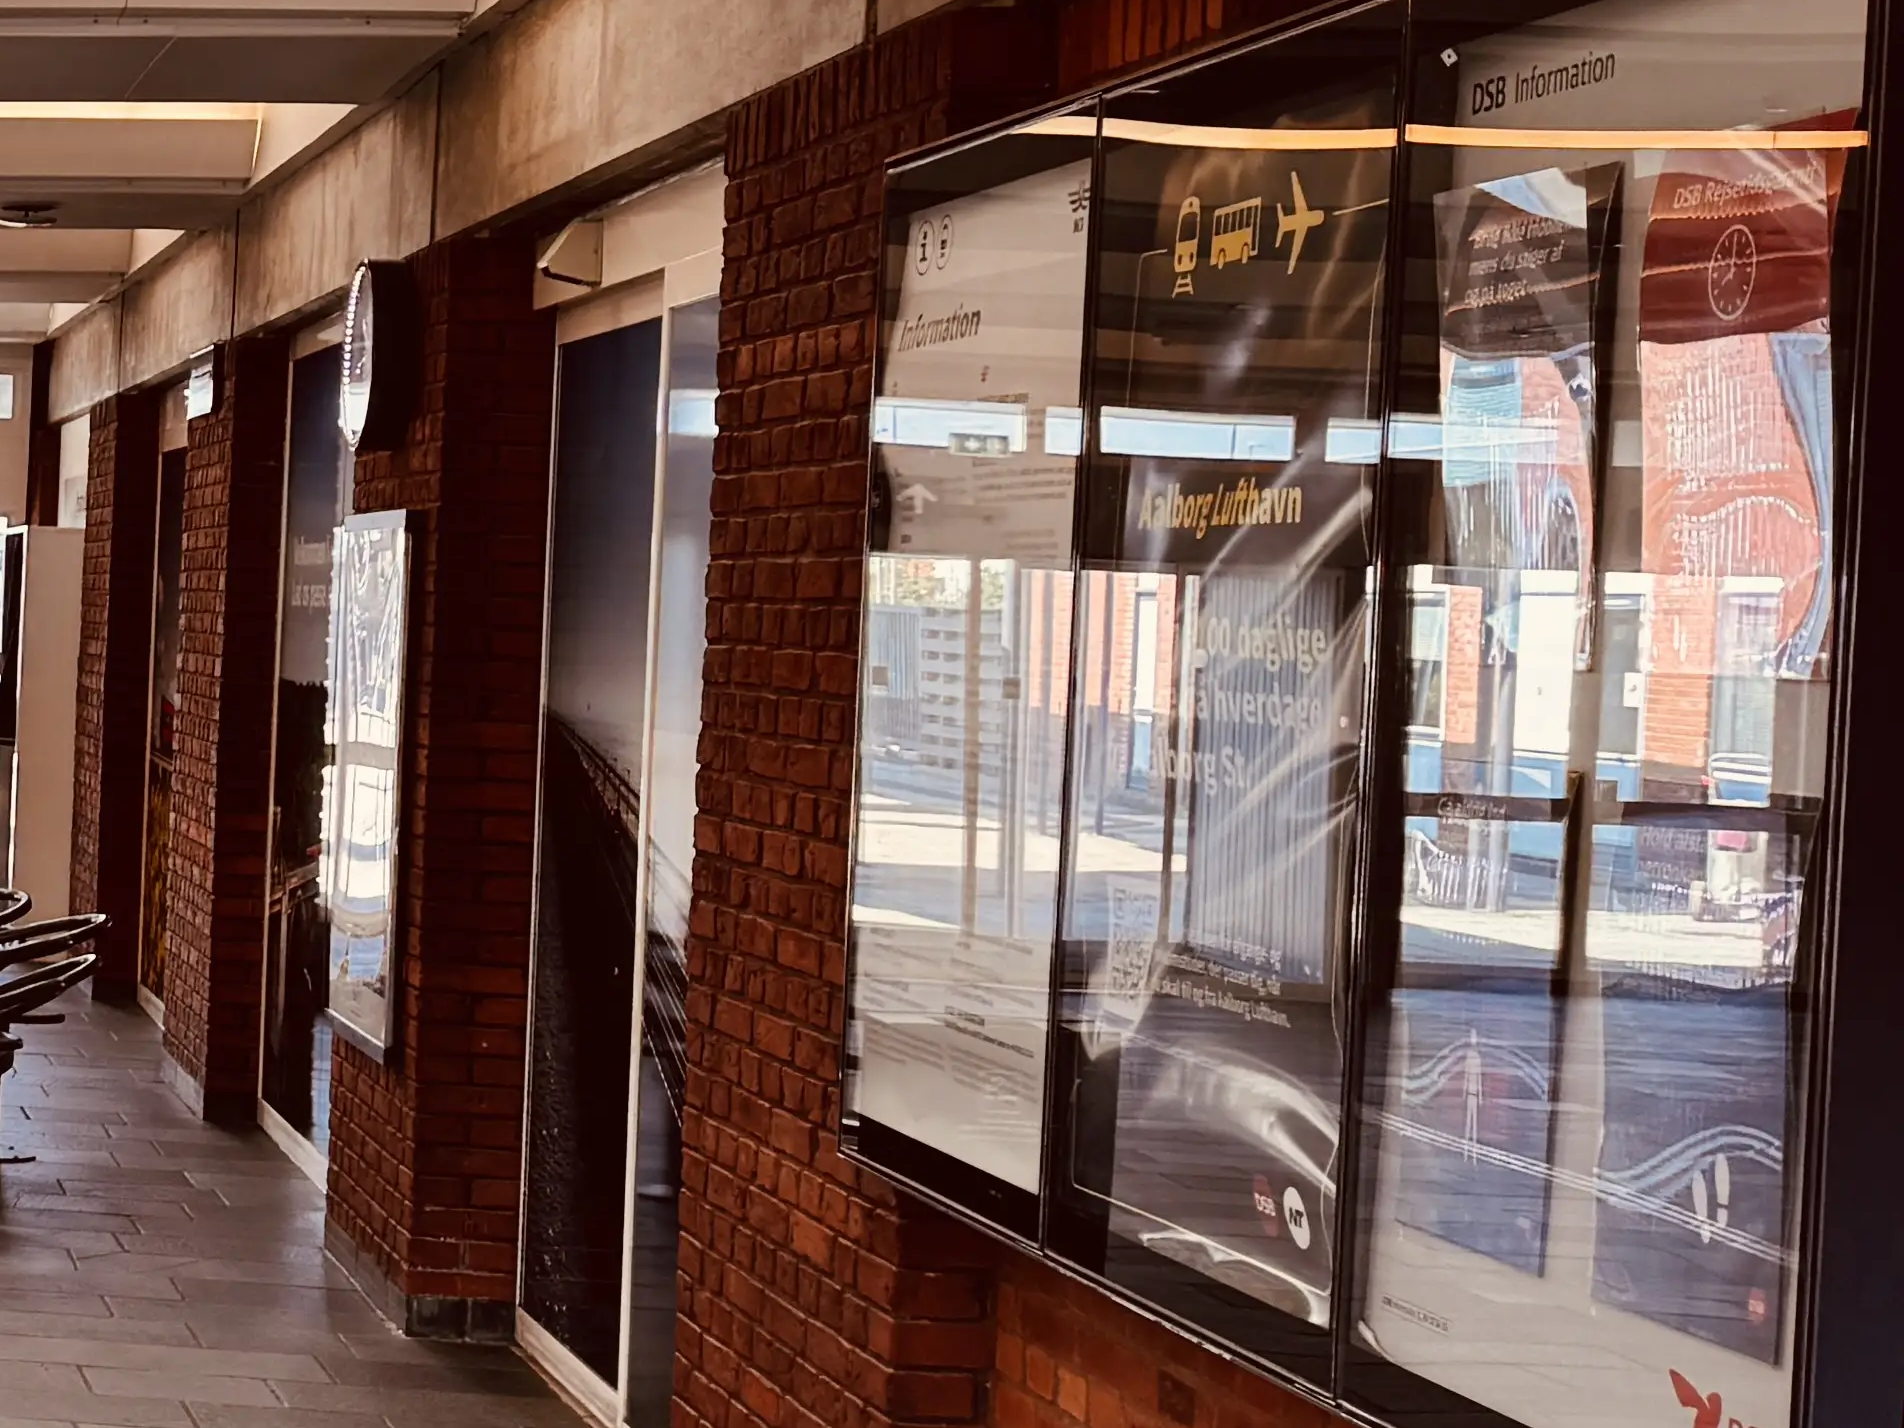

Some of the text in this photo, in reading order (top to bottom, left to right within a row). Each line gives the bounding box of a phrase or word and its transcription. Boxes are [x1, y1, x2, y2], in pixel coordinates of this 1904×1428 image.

[1472, 51, 1616, 115] DSB Information
[898, 302, 981, 353] Information
[1138, 476, 1303, 539] Aalborg Lufthavn
[1237, 616, 1328, 672] daglige
[1214, 675, 1321, 734] hverdage
[1254, 1192, 1304, 1229] DSB NT
